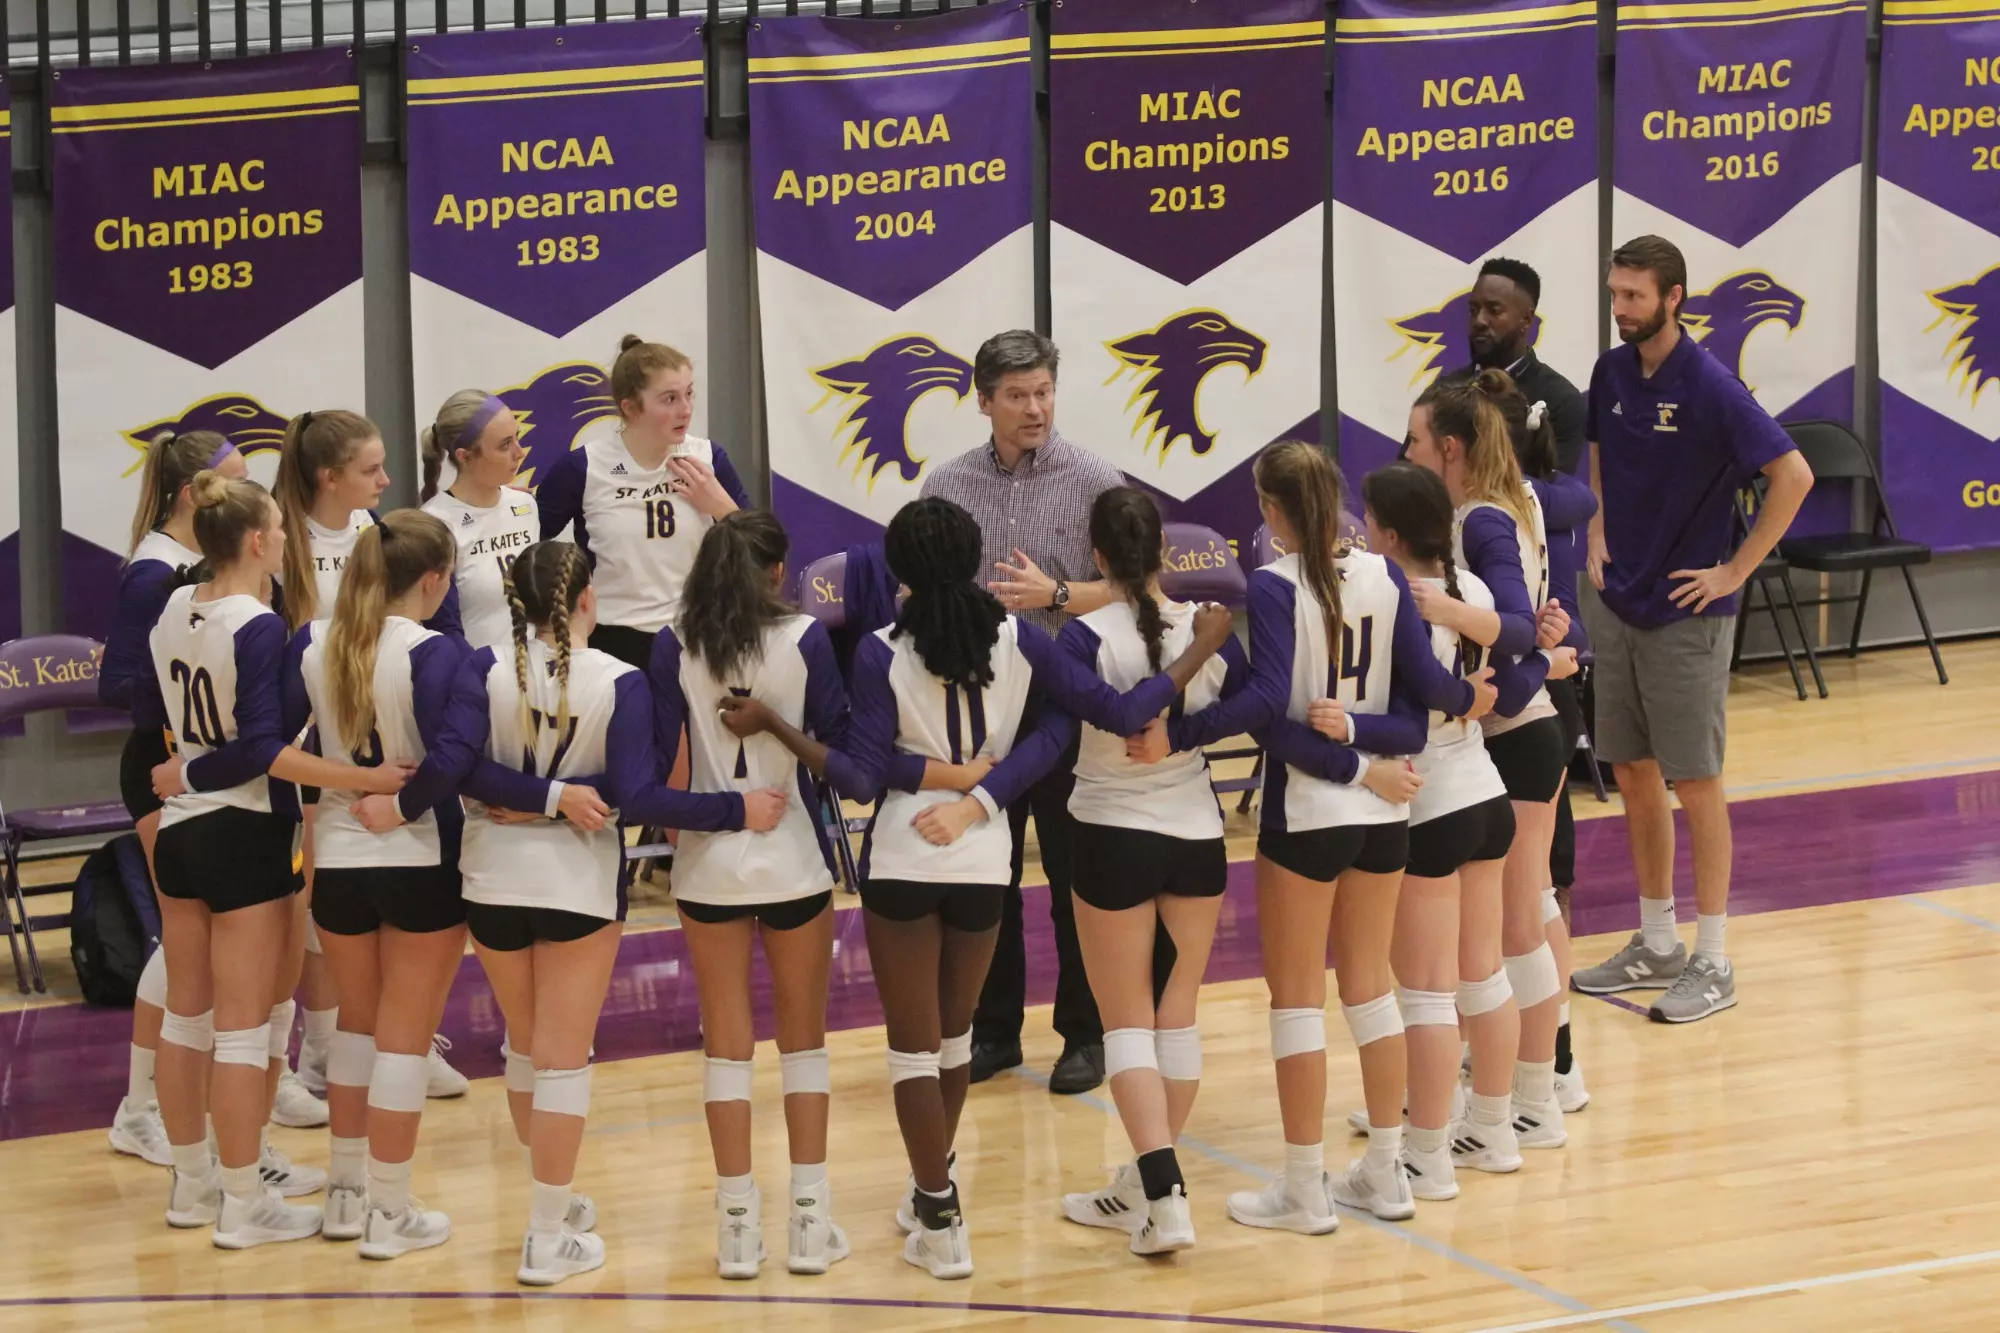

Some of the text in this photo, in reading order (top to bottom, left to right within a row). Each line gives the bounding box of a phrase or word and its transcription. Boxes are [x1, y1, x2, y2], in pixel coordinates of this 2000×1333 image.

[1423, 74, 1524, 107] NCAA
[1698, 60, 1791, 94] MIAC
[1140, 89, 1240, 122] MIAC
[1643, 102, 1831, 140] Champions
[1904, 104, 2000, 137] Appe
[844, 114, 950, 150] NCAA
[1358, 117, 1574, 162] Appearance
[502, 136, 614, 172] NCAA
[1085, 133, 1289, 172] Champions
[1706, 152, 1779, 181] 2016
[154, 160, 264, 198] MIAC
[775, 158, 1006, 206] Appearance
[1434, 166, 1508, 196] 2016
[434, 184, 677, 231] Appearance
[1150, 184, 1225, 212] 2013
[95, 208, 322, 252] Champions
[856, 210, 936, 240] 2004
[518, 235, 599, 265] 1983
[169, 261, 252, 293] 1983
[646, 500, 676, 539] 18
[490, 530, 532, 552] KATE'S
[1160, 541, 1226, 573] Kate's
[812, 576, 843, 603] St.
[0, 649, 100, 689] St. Kate'
[170, 658, 225, 748] 20
